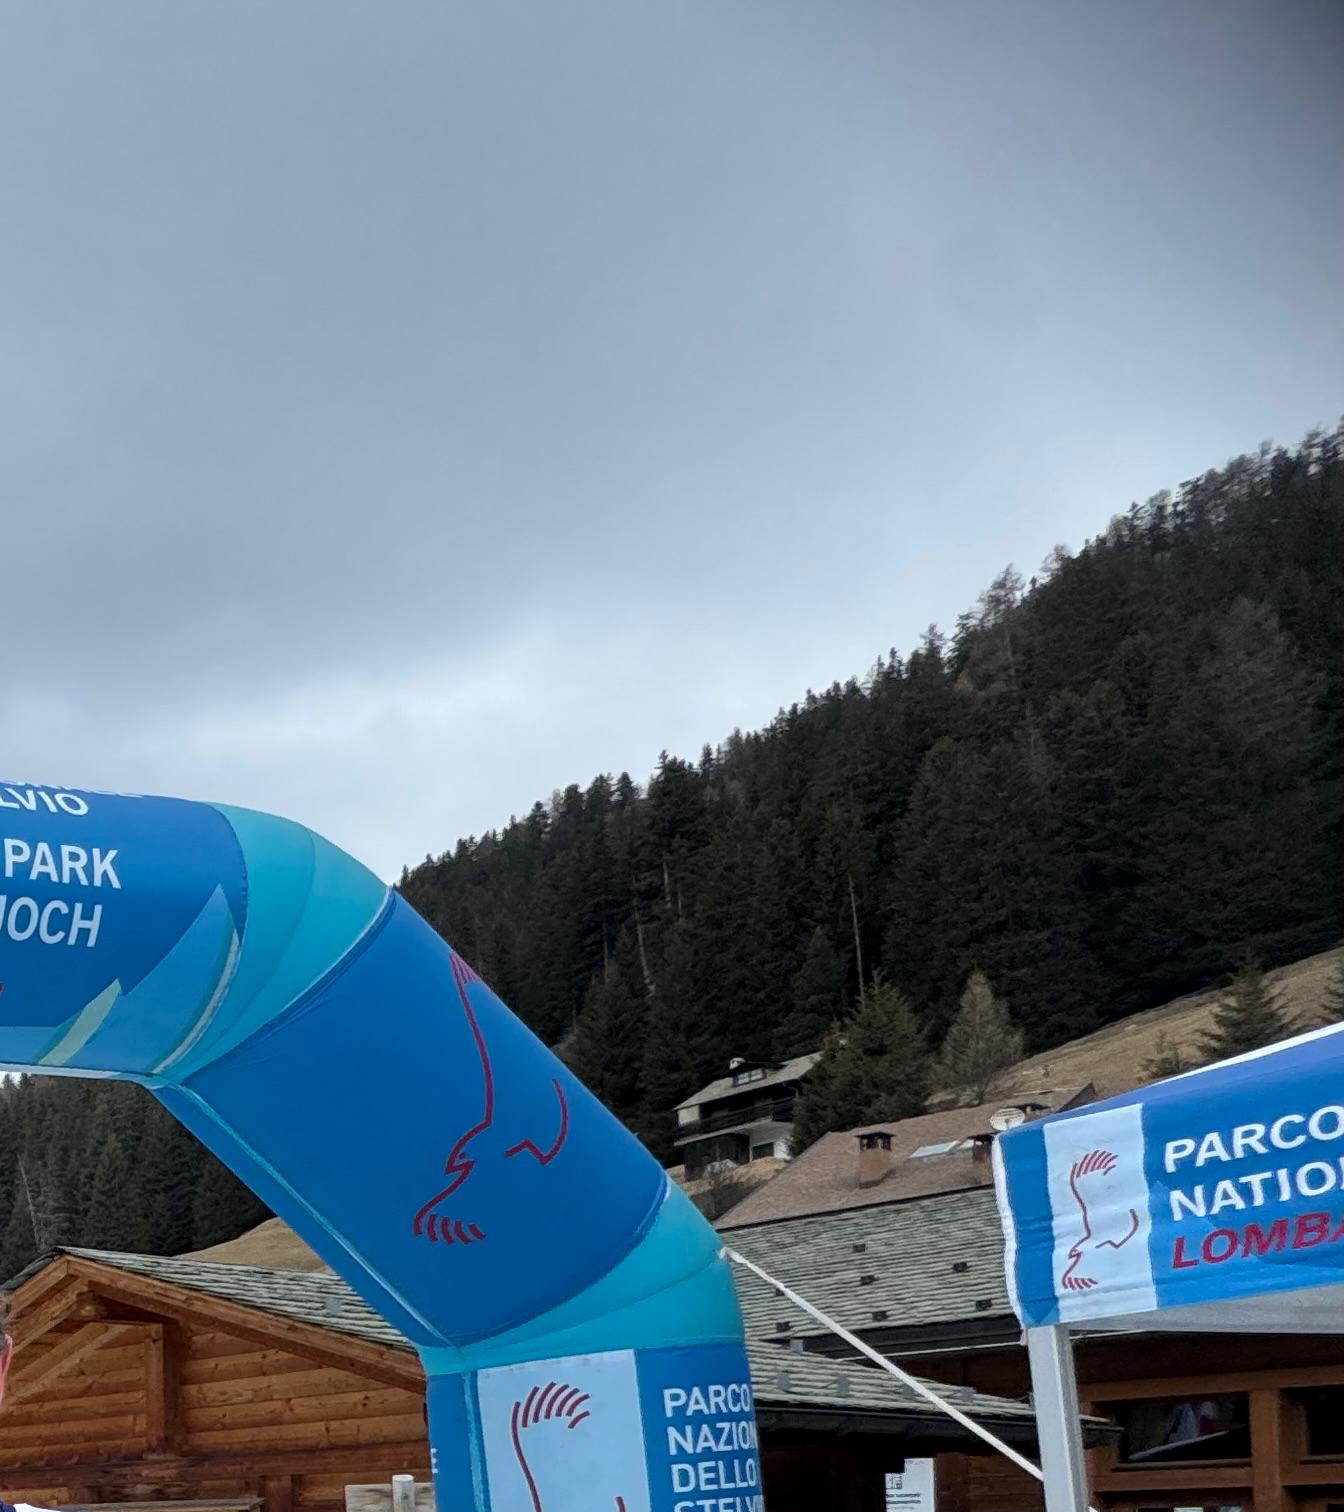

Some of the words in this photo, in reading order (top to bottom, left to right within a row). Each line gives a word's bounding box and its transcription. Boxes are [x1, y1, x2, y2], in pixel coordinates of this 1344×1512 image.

[2, 838, 121, 890] PARK
[1164, 1105, 1344, 1173] PARCO
[1169, 1161, 1344, 1221] NATIO
[663, 1384, 751, 1418] PARCO
[671, 1459, 758, 1493] DELLO
